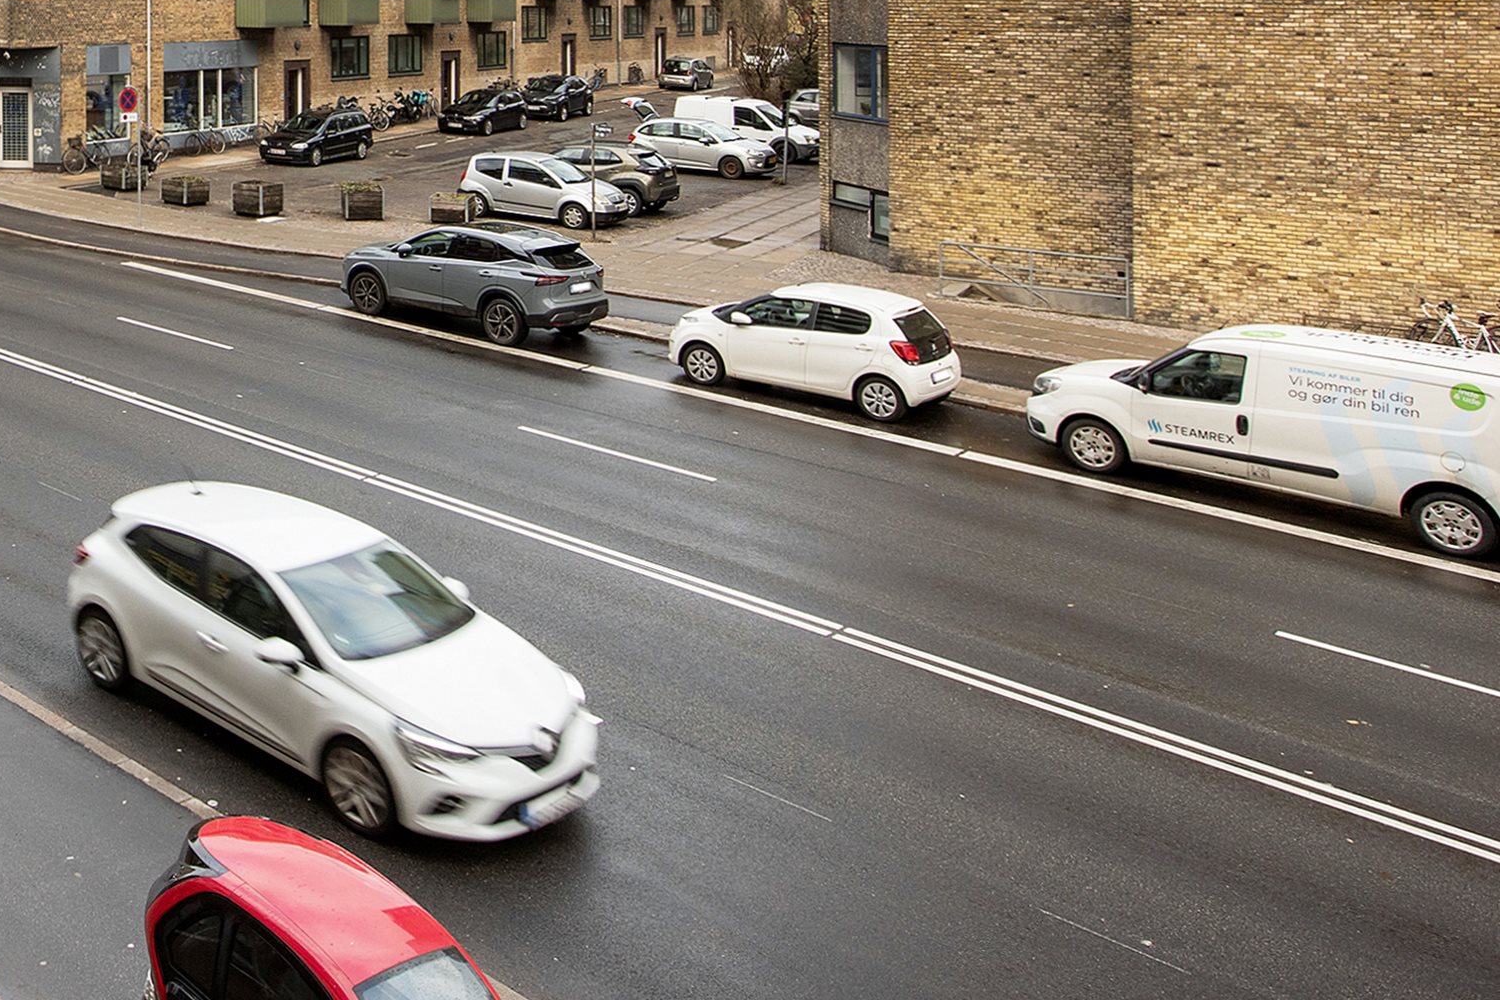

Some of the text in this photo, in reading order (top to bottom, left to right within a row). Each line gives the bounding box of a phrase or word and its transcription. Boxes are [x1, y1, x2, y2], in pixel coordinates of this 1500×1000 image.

[1289, 367, 1326, 377] STEAMING
[1340, 374, 1361, 382] BILER
[1288, 374, 1414, 407] Vi kommer til dig
[1287, 389, 1420, 419] og gør din bil ren
[1164, 423, 1235, 445] STEAMREX
